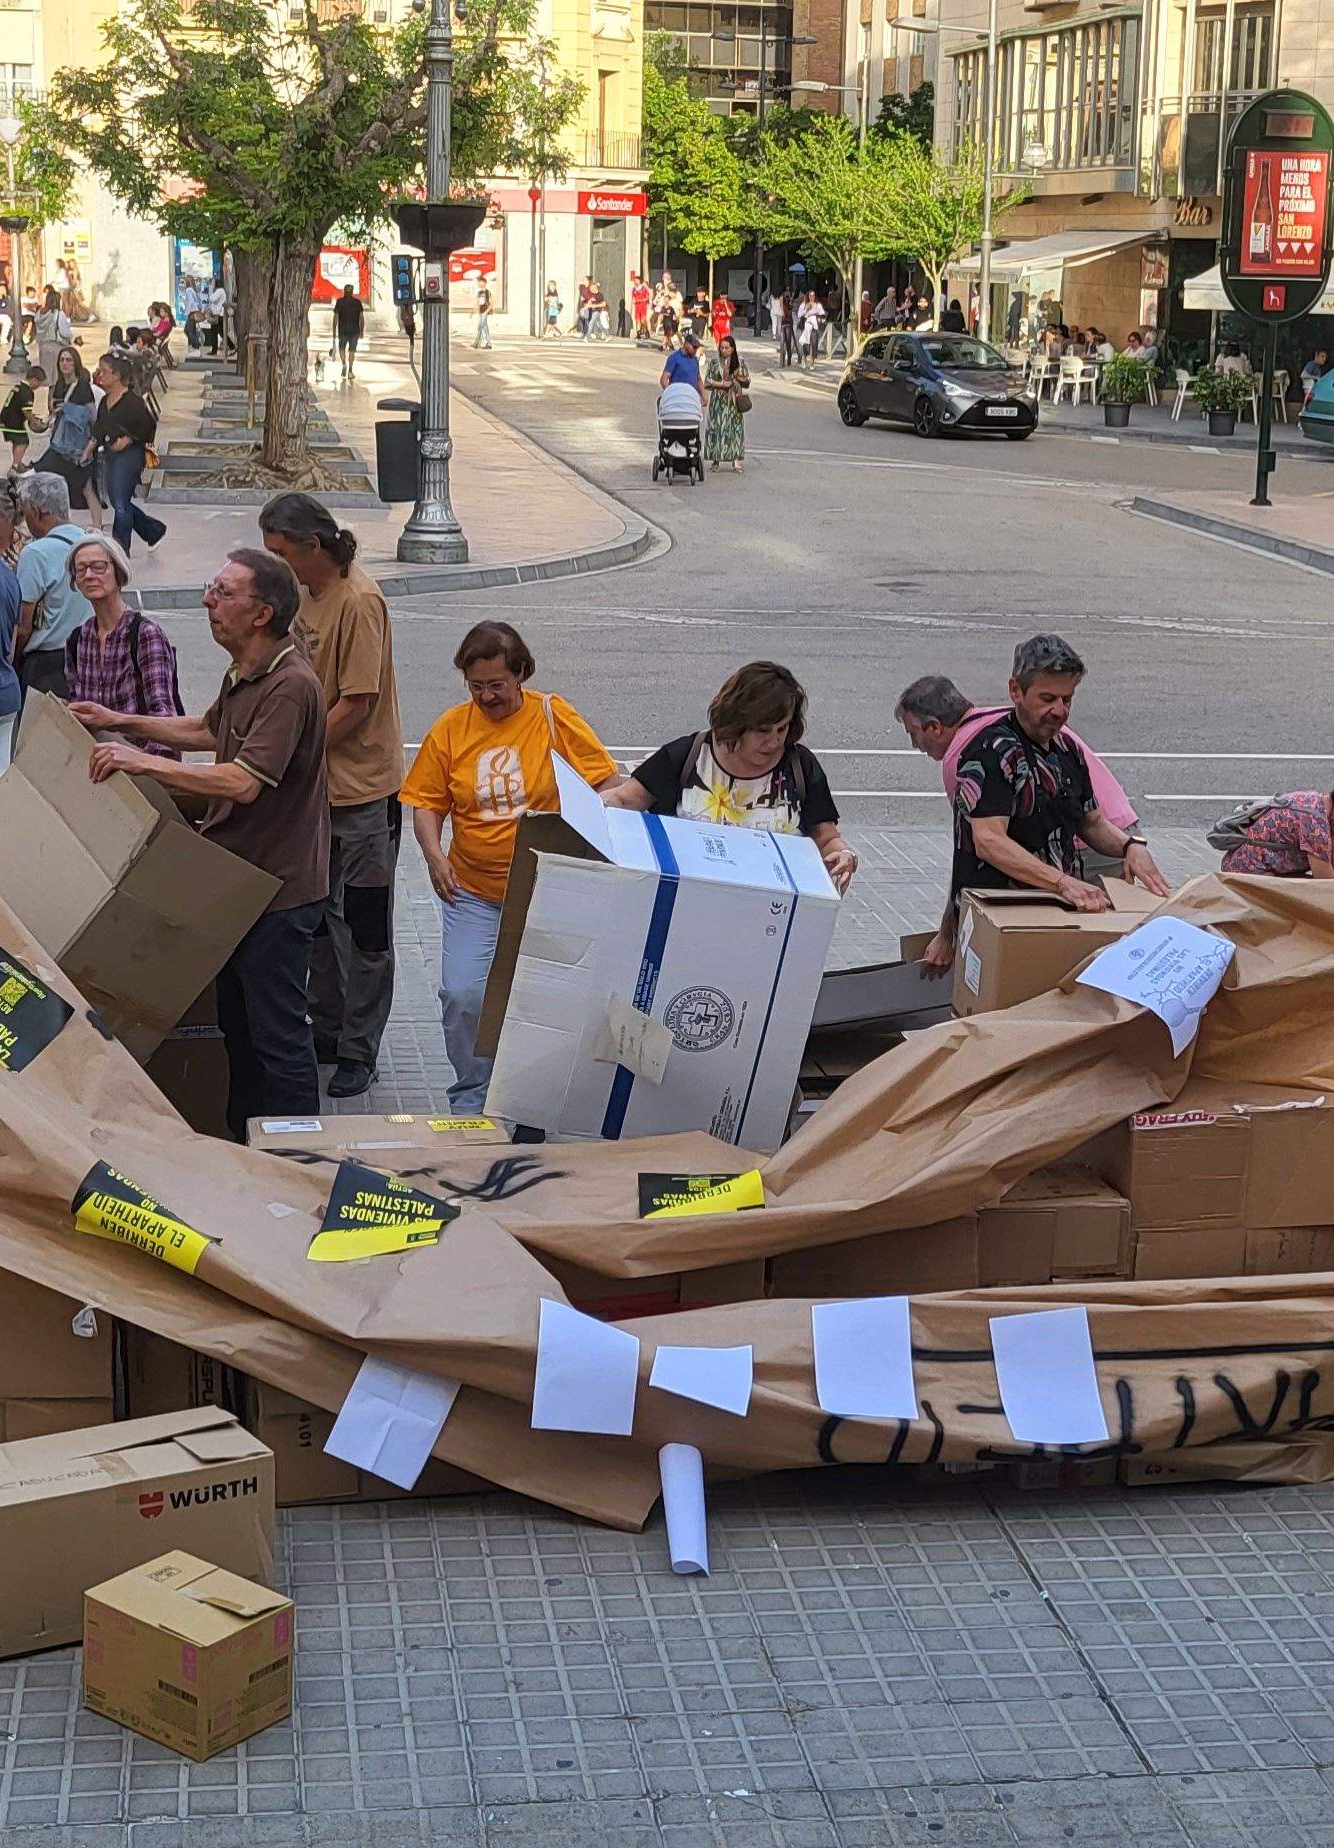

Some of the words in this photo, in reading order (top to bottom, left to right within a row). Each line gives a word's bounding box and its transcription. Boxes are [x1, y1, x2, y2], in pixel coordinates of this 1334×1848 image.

[1281, 158, 1298, 172] UNA
[1300, 158, 1322, 172] HORA
[1280, 172, 1309, 185] MENOS
[1279, 186, 1303, 199] PARA
[1303, 187, 1313, 199] EL
[596, 196, 634, 211] Santander
[1174, 196, 1212, 226] Bar
[1278, 199, 1315, 213] PRÓXIMO
[1277, 213, 1295, 226] SAN
[1276, 225, 1313, 240] LORENZO
[140, 1198, 158, 1211] NO
[355, 1191, 435, 1217] PALESTINAS
[92, 1191, 168, 1239] APARTHEID
[339, 1204, 410, 1226] VIVIENDAS
[100, 1216, 166, 1258] DERRIBEN
[169, 1228, 186, 1249] EL
[169, 1475, 259, 1510] WÜRTH
